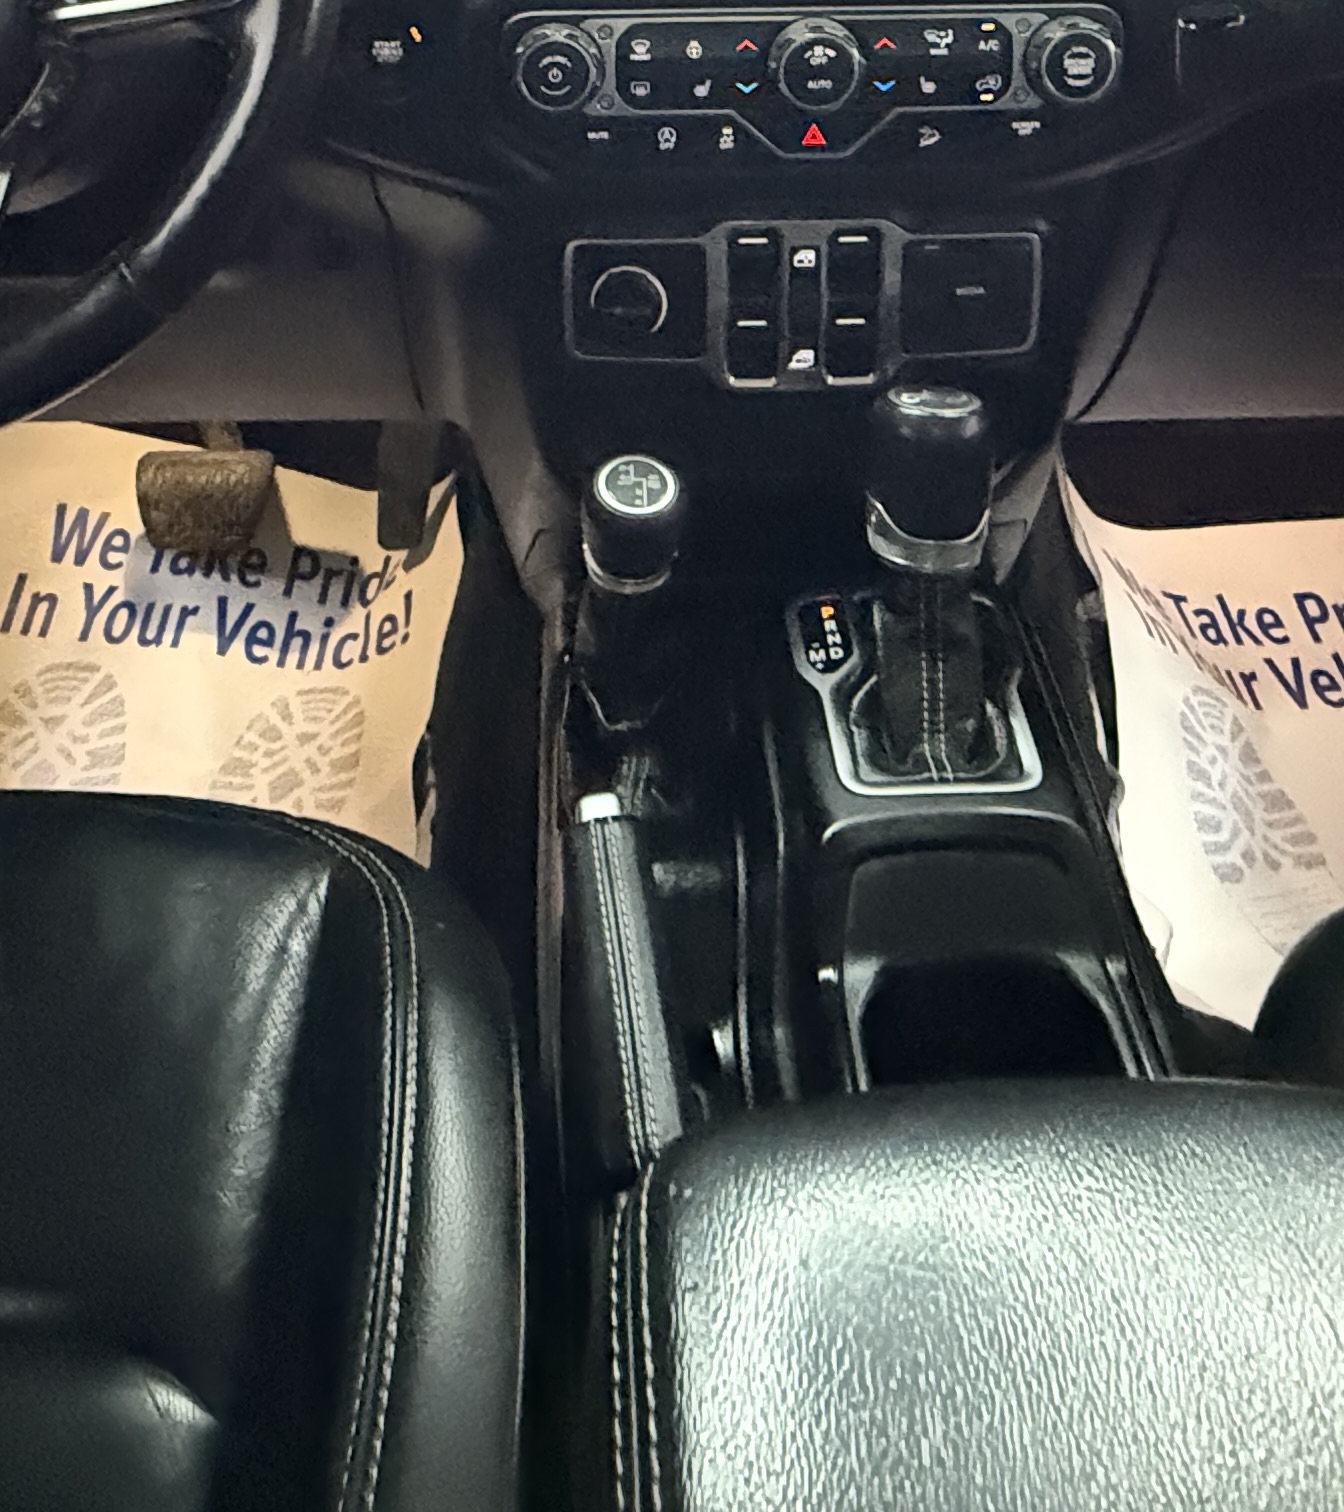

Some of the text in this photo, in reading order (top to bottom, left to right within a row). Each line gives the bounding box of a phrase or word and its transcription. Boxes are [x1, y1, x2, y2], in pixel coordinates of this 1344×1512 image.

[978, 40, 1000, 51] A/C
[807, 80, 833, 90] AUTO
[50, 503, 132, 571] We
[821, 606, 834, 619] P
[1161, 590, 1291, 647] Take
[0, 573, 413, 671] In Your Vehicle!
[826, 632, 842, 646] N
[809, 648, 826, 663] M
[829, 646, 844, 660] D
